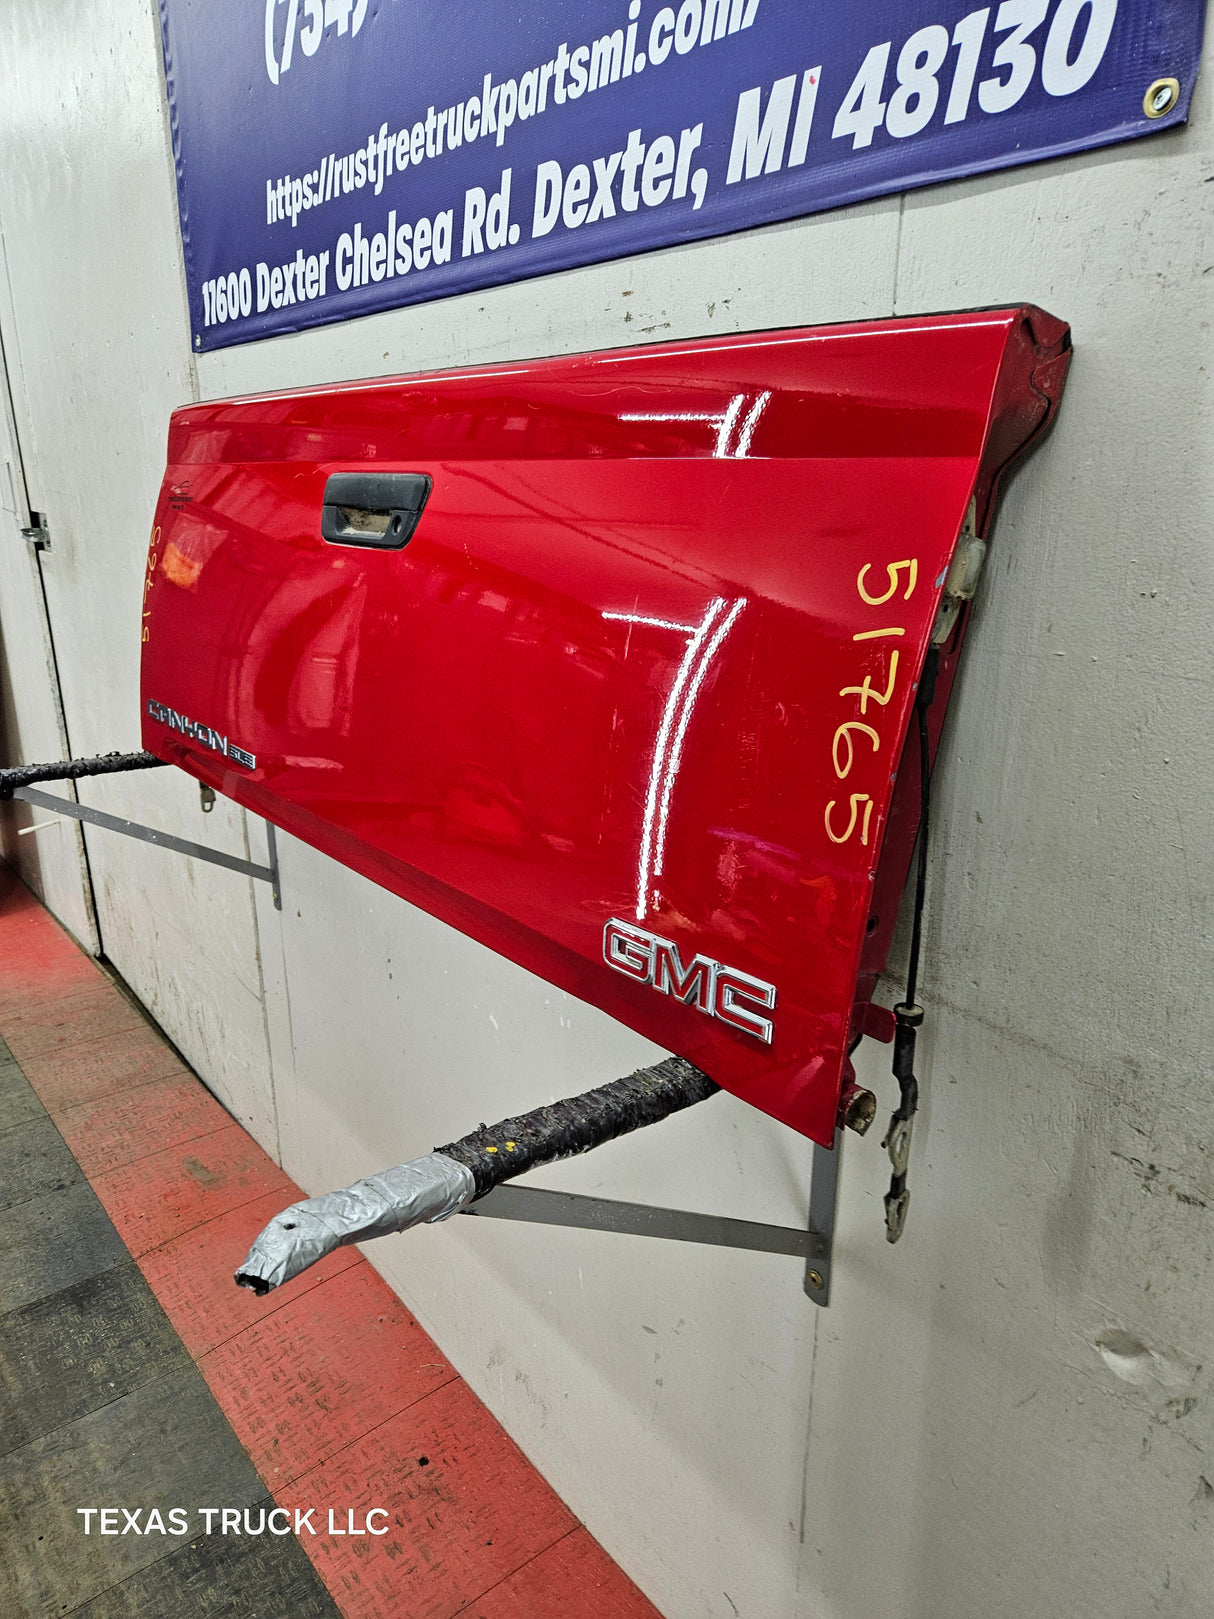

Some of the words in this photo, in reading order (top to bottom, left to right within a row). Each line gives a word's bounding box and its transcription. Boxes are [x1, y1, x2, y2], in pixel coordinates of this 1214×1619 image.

[202, 267, 252, 326] 11600
[256, 248, 330, 313] Dexter
[335, 210, 453, 291] Chelsea
[461, 168, 521, 258] Rd.
[531, 122, 708, 239] Dexter,
[725, 65, 823, 185] MI
[831, 0, 1118, 150] 48130
[147, 698, 229, 756] CANYON
[825, 558, 918, 846] 51765
[602, 916, 777, 1045] GMC
